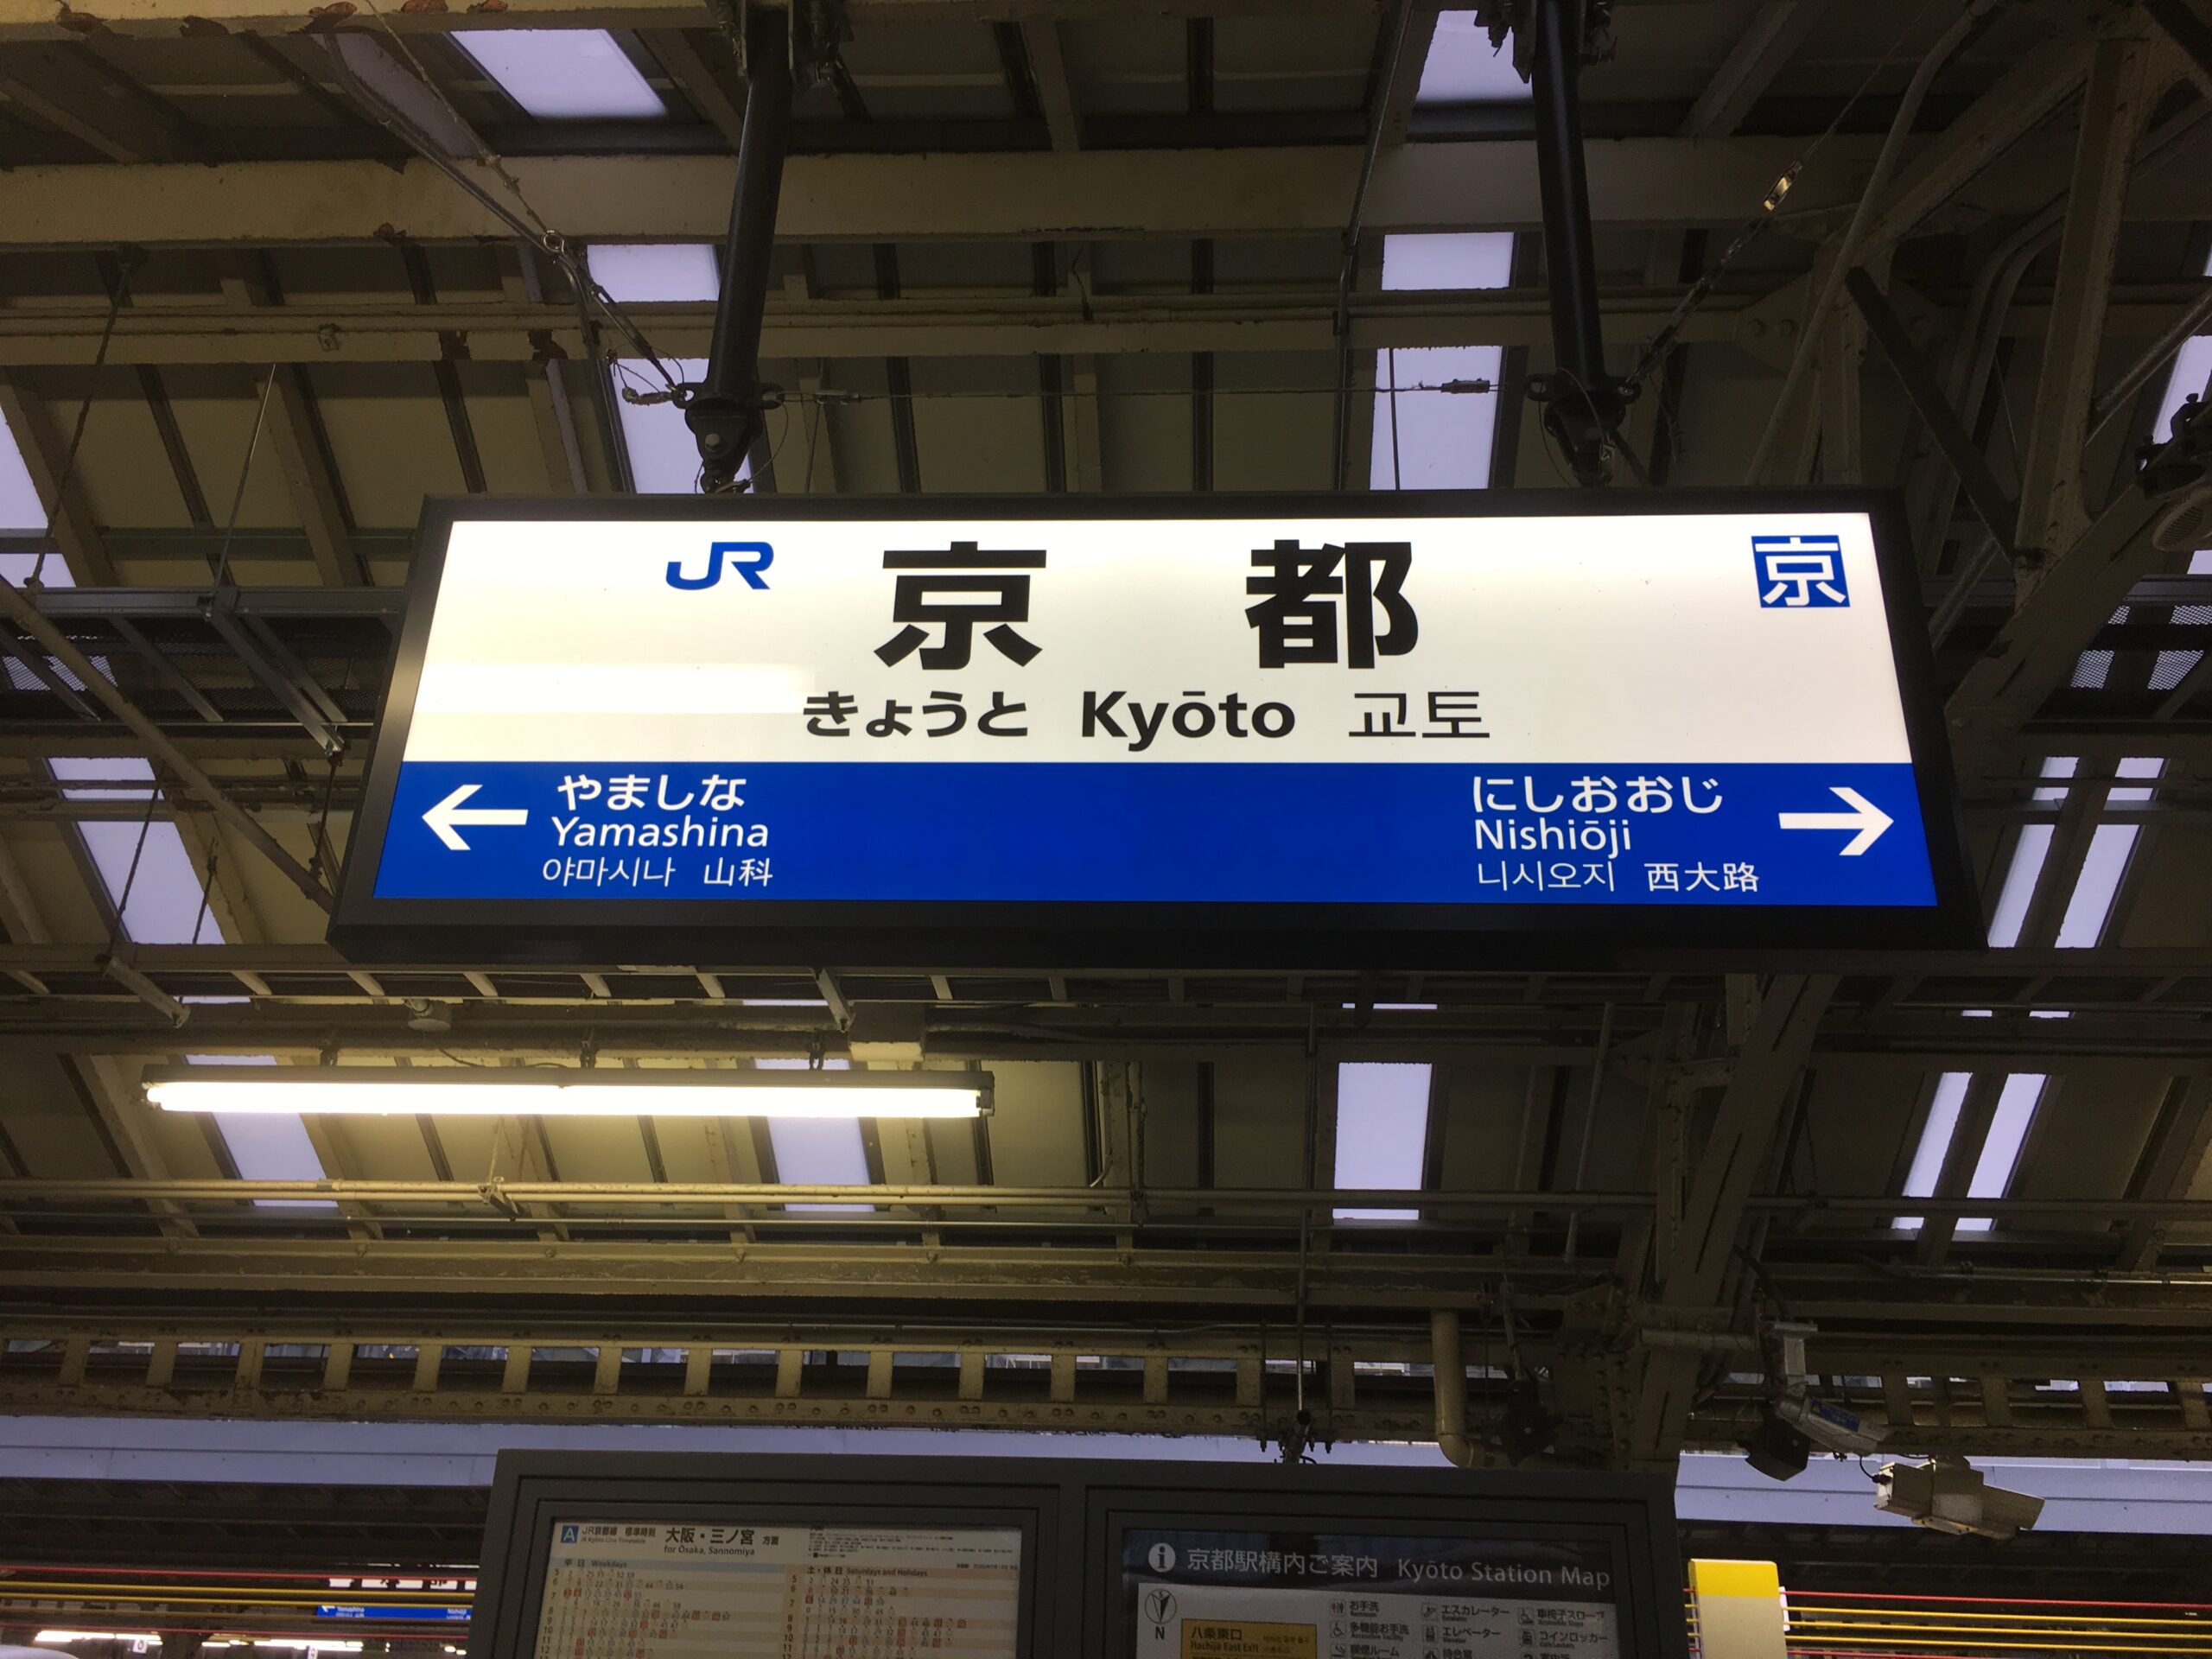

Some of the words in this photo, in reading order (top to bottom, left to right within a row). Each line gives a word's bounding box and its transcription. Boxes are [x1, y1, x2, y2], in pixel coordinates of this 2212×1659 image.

[666, 542, 774, 590] JR
[1752, 536, 1849, 607] 京
[803, 690, 1028, 738] きょうと
[1082, 690, 1295, 752] Kyōto
[1349, 691, 1491, 738] 교토
[556, 773, 747, 810] やましな
[1473, 775, 1724, 814] にしおおじ
[551, 815, 769, 847] Yamashina
[1475, 817, 1631, 859] Nishiōji
[542, 856, 677, 887] 야마시나
[703, 857, 773, 887] 山科
[1478, 861, 1615, 892] 니시오지
[1644, 861, 1761, 892] 西大路
[563, 1527, 576, 1542] A
[664, 1527, 755, 1546] 大阪・三ノ宮
[591, 1560, 627, 1569] Weekdays
[664, 1545, 677, 1554] for
[709, 1547, 755, 1557] Sannomiya
[1186, 1548, 1378, 1578] 京都駅構内ご案内
[1398, 1558, 1464, 1583] Kyōto
[1471, 1561, 1553, 1585] Station
[1561, 1566, 1611, 1590] Map
[1350, 1600, 1380, 1612] お手洗
[1441, 1605, 1510, 1618] エスカレーター
[1155, 1627, 1165, 1639] N
[1443, 1627, 1501, 1639] エレベーター
[1540, 1630, 1608, 1643] コインロッカー
